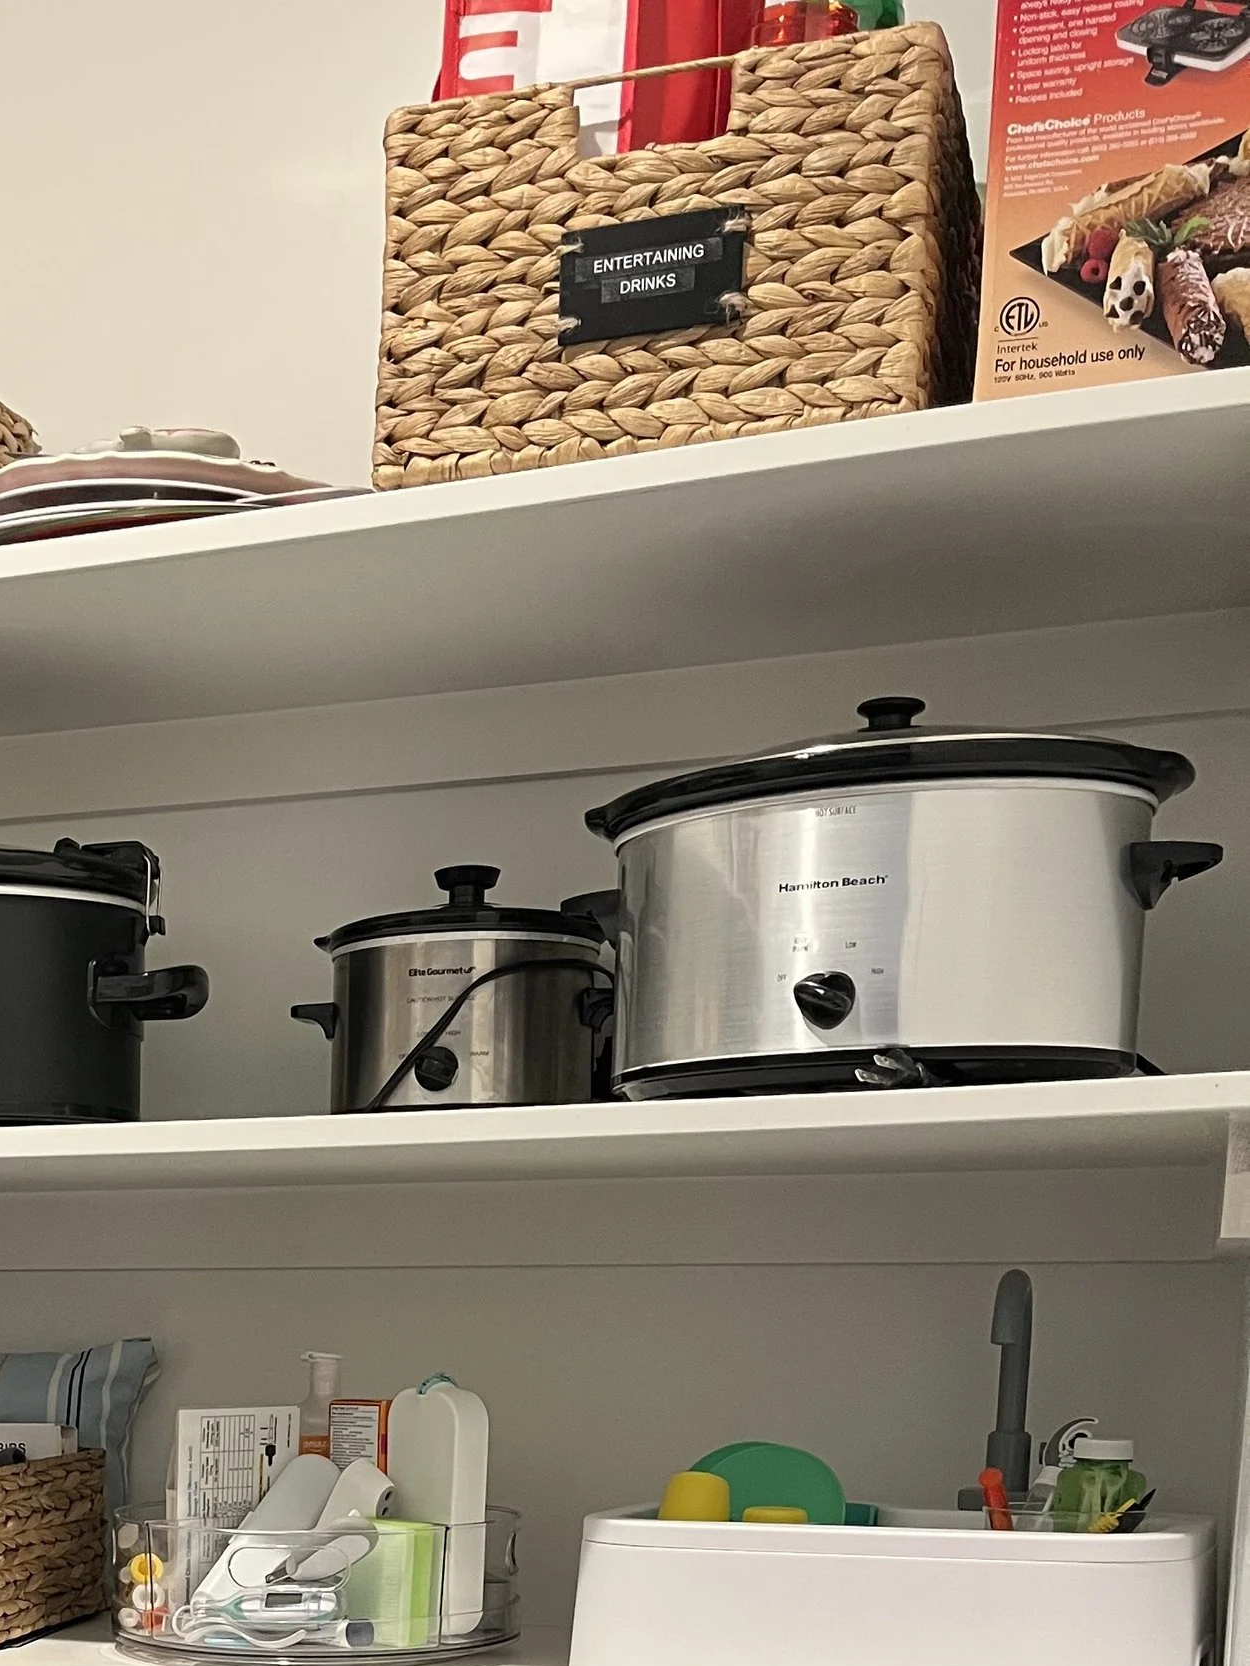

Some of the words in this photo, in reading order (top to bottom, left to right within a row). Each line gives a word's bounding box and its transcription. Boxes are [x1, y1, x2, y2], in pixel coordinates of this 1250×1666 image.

[1061, 8, 1081, 17] easy
[1052, 30, 1068, 40] and
[1071, 40, 1082, 50] for
[1017, 56, 1048, 67] uniform
[1049, 51, 1086, 63] thickness
[1023, 81, 1041, 92] year
[1042, 77, 1078, 88] warranty
[1015, 92, 1048, 104] Recipes
[1049, 88, 1083, 99] included
[1093, 108, 1146, 125] Products
[592, 243, 706, 275] ENTERTAINING
[619, 272, 677, 295] DRINKS
[997, 342, 1038, 355] Intertek
[995, 358, 1016, 373] For
[1019, 350, 1088, 371] household
[1091, 348, 1114, 363] use
[1118, 344, 1146, 361] only
[778, 879, 840, 894] Hamilton
[408, 968, 427, 977] Elite
[427, 966, 463, 976] Gourmet
